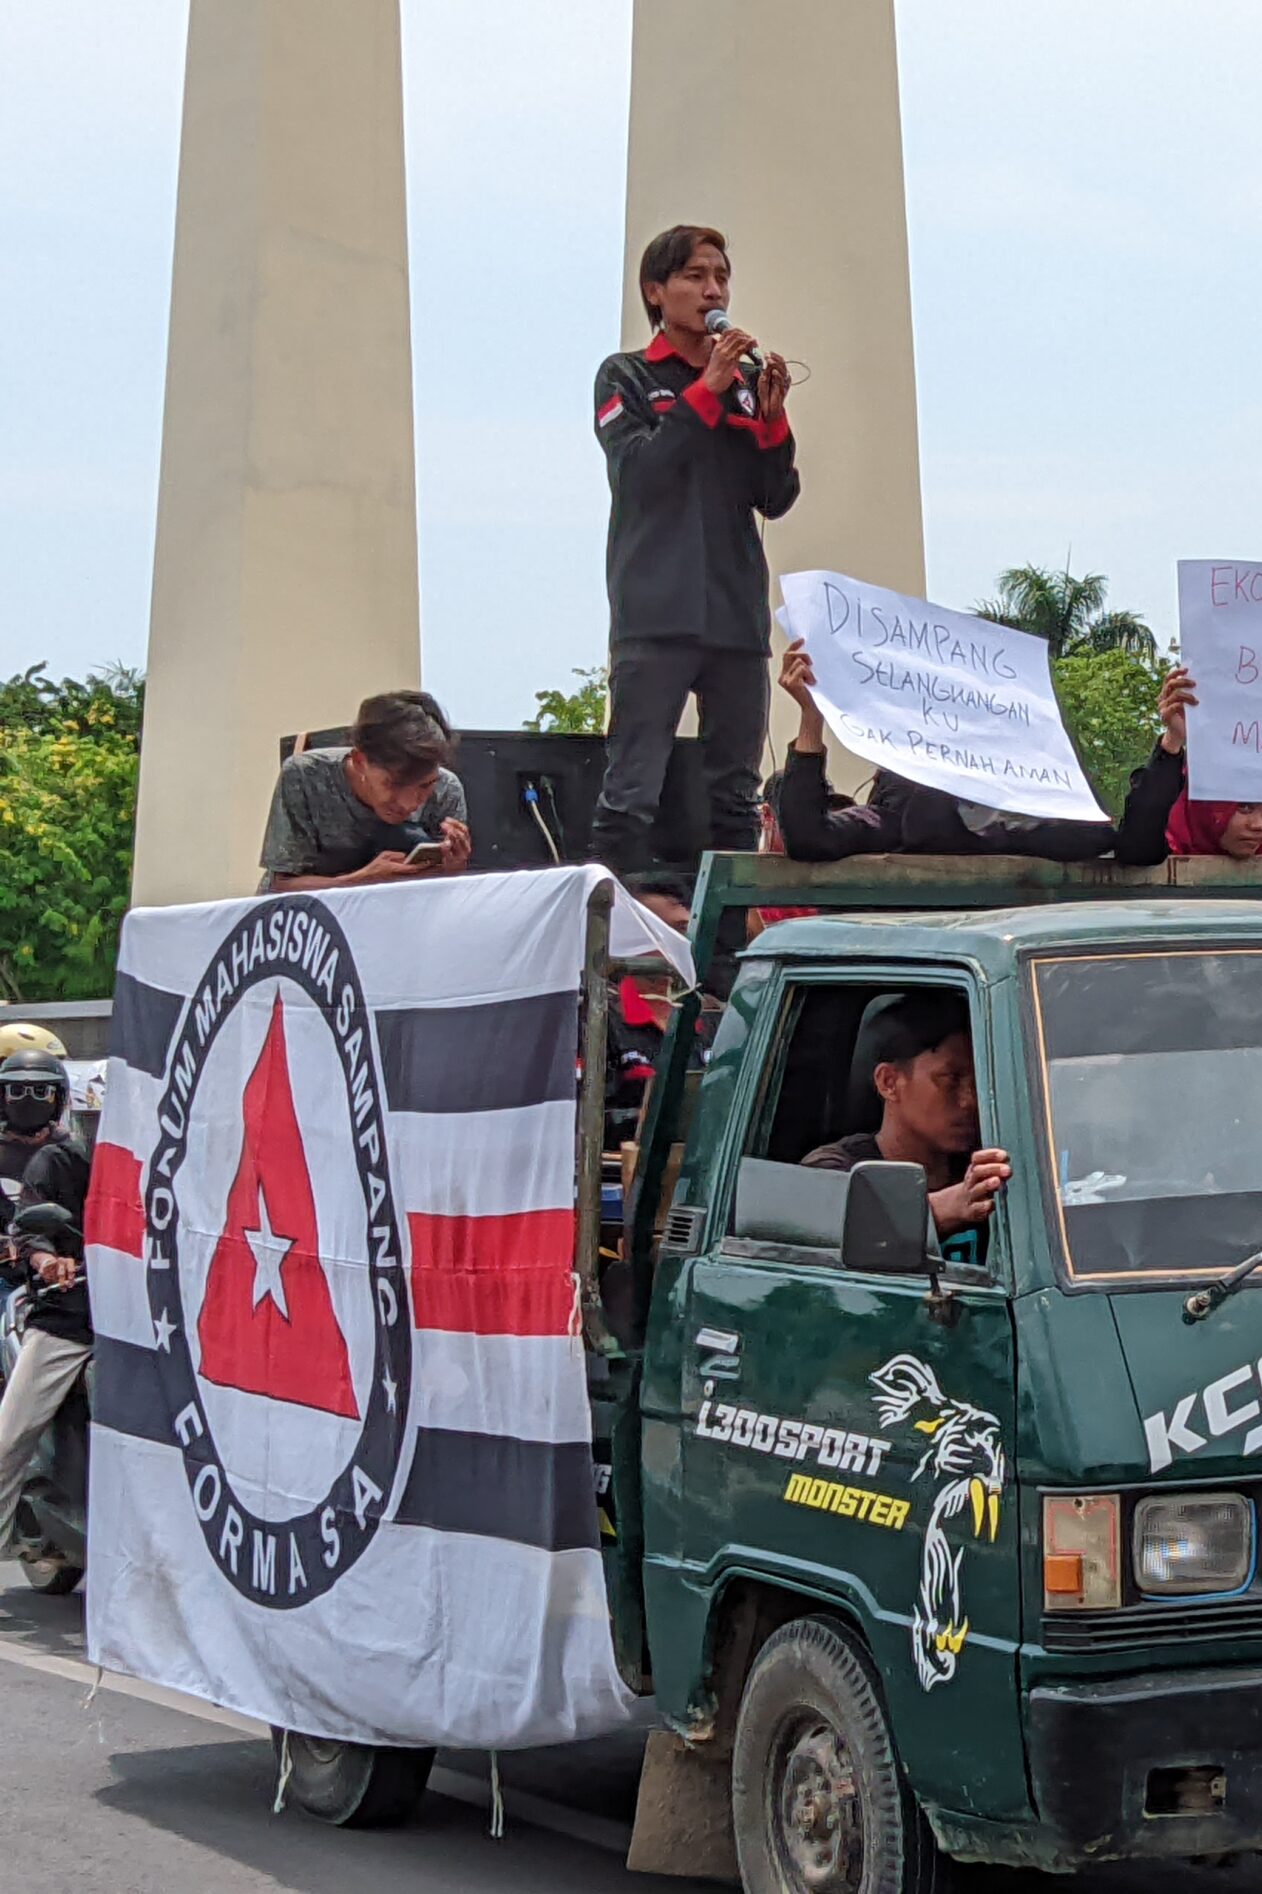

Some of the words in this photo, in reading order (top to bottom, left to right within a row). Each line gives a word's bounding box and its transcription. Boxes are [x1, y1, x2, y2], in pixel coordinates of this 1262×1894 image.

[823, 581, 1017, 680] DISAMPANG
[839, 713, 896, 751] GAK
[907, 730, 996, 776] PERNAH
[1003, 758, 1072, 790] AMAN
[922, 698, 958, 732] KU
[194, 909, 339, 1049] MAHASISWA
[174, 1400, 385, 1596] FORMASA
[784, 1473, 911, 1530] MONSTER
